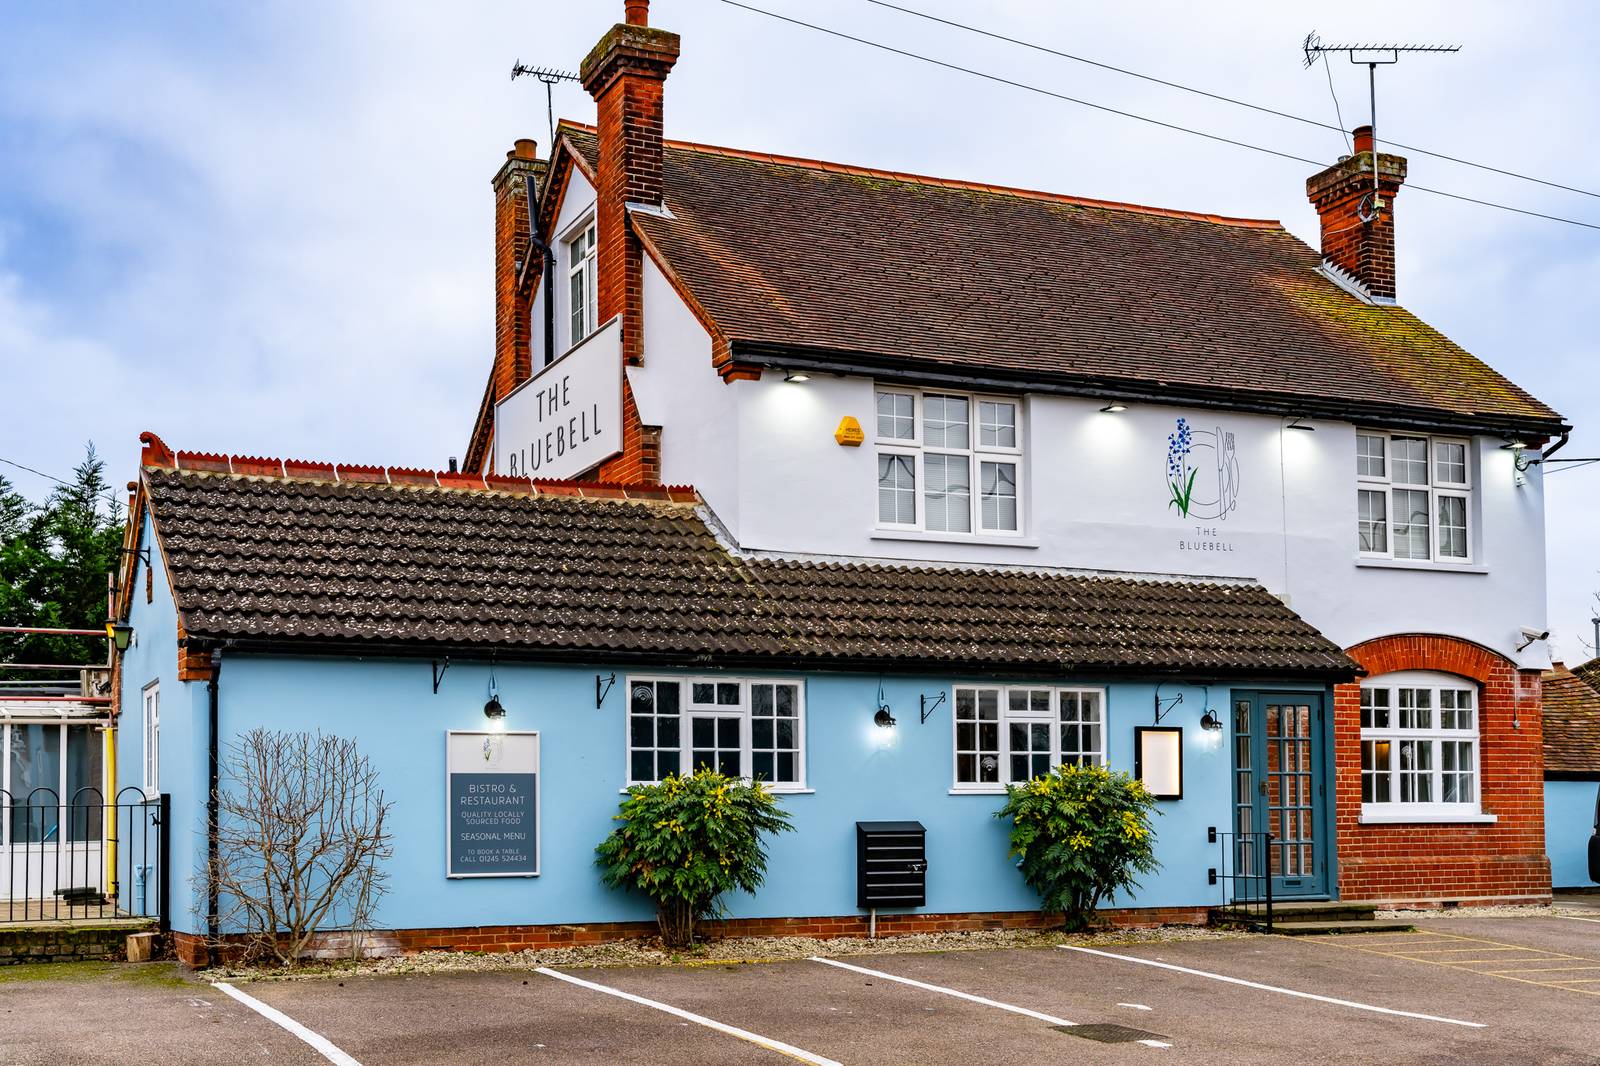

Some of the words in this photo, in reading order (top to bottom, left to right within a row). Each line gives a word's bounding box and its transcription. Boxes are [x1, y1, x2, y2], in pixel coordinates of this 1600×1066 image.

[536, 375, 570, 422] THE
[510, 403, 602, 478] BLUEBELL
[1195, 526, 1217, 537] THE
[1179, 540, 1234, 552] BLUEBELL
[469, 784, 505, 793] BISTRO
[509, 784, 517, 793] &
[460, 796, 525, 805] RESTAURANT
[460, 832, 501, 841] SEASONAL
[504, 832, 526, 840] MENU
